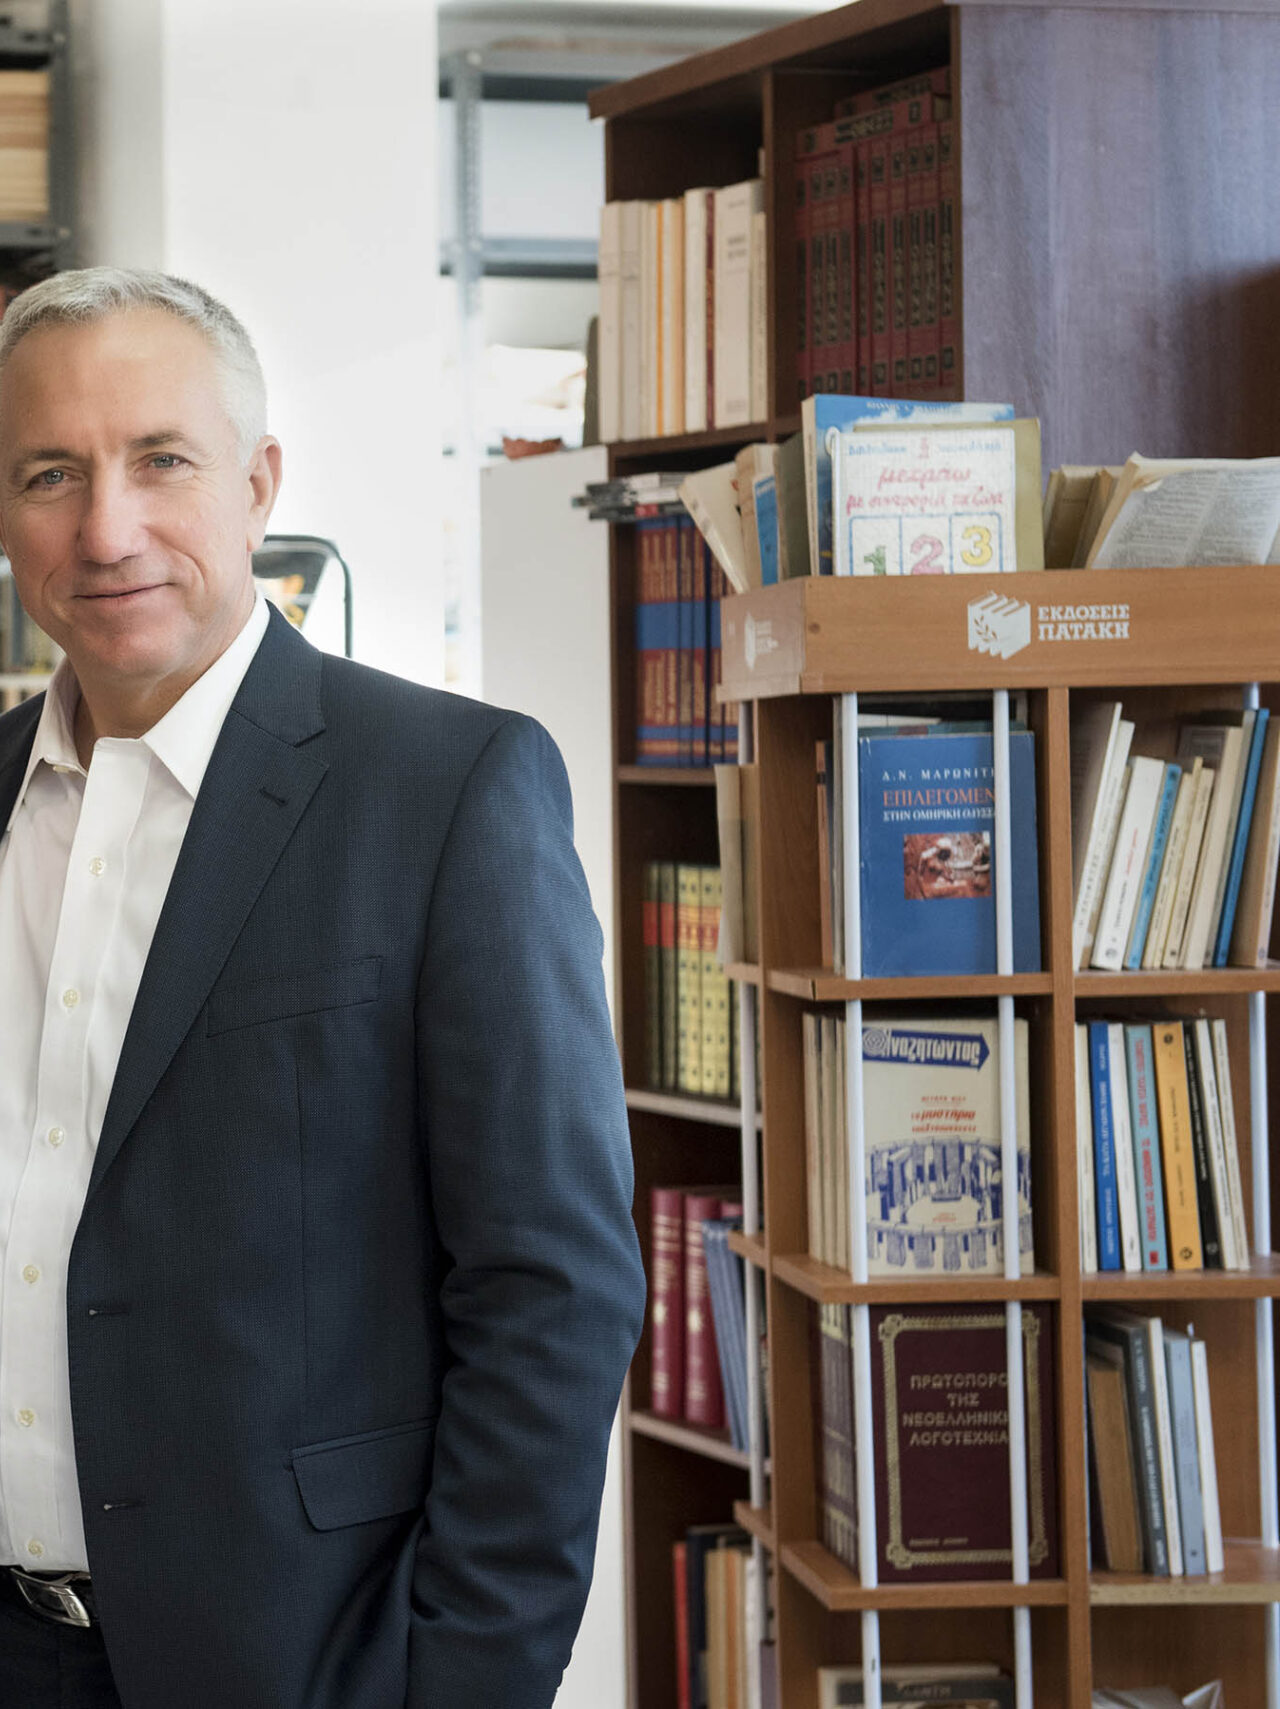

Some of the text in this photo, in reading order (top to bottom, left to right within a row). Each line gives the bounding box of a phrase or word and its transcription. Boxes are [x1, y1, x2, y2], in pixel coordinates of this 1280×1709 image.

[961, 525, 994, 568] 3
[1037, 604, 1130, 622] ΕΚΔΟΣΕΙΣ
[1038, 622, 1130, 641] ΠΑΤΑΚΗ
[921, 767, 995, 780] ΜΑΡΩΝΙΤ
[883, 787, 995, 807] ΕΠΙΛΕΓΟΜΕΝ
[883, 810, 911, 822] ΣΤΗΝ
[912, 808, 961, 821] ΟΜΗΡΙΚΗ
[910, 1372, 1008, 1390] ΠΡΩΤΟΠΟΡΟ
[947, 1392, 980, 1408] ΤΗΣ
[902, 1410, 1009, 1428] ΝΕΟΕΛΛΗΝΙΚ
[910, 1430, 1010, 1447] ΛΟΓΟΤΕΧΝΙΑ
